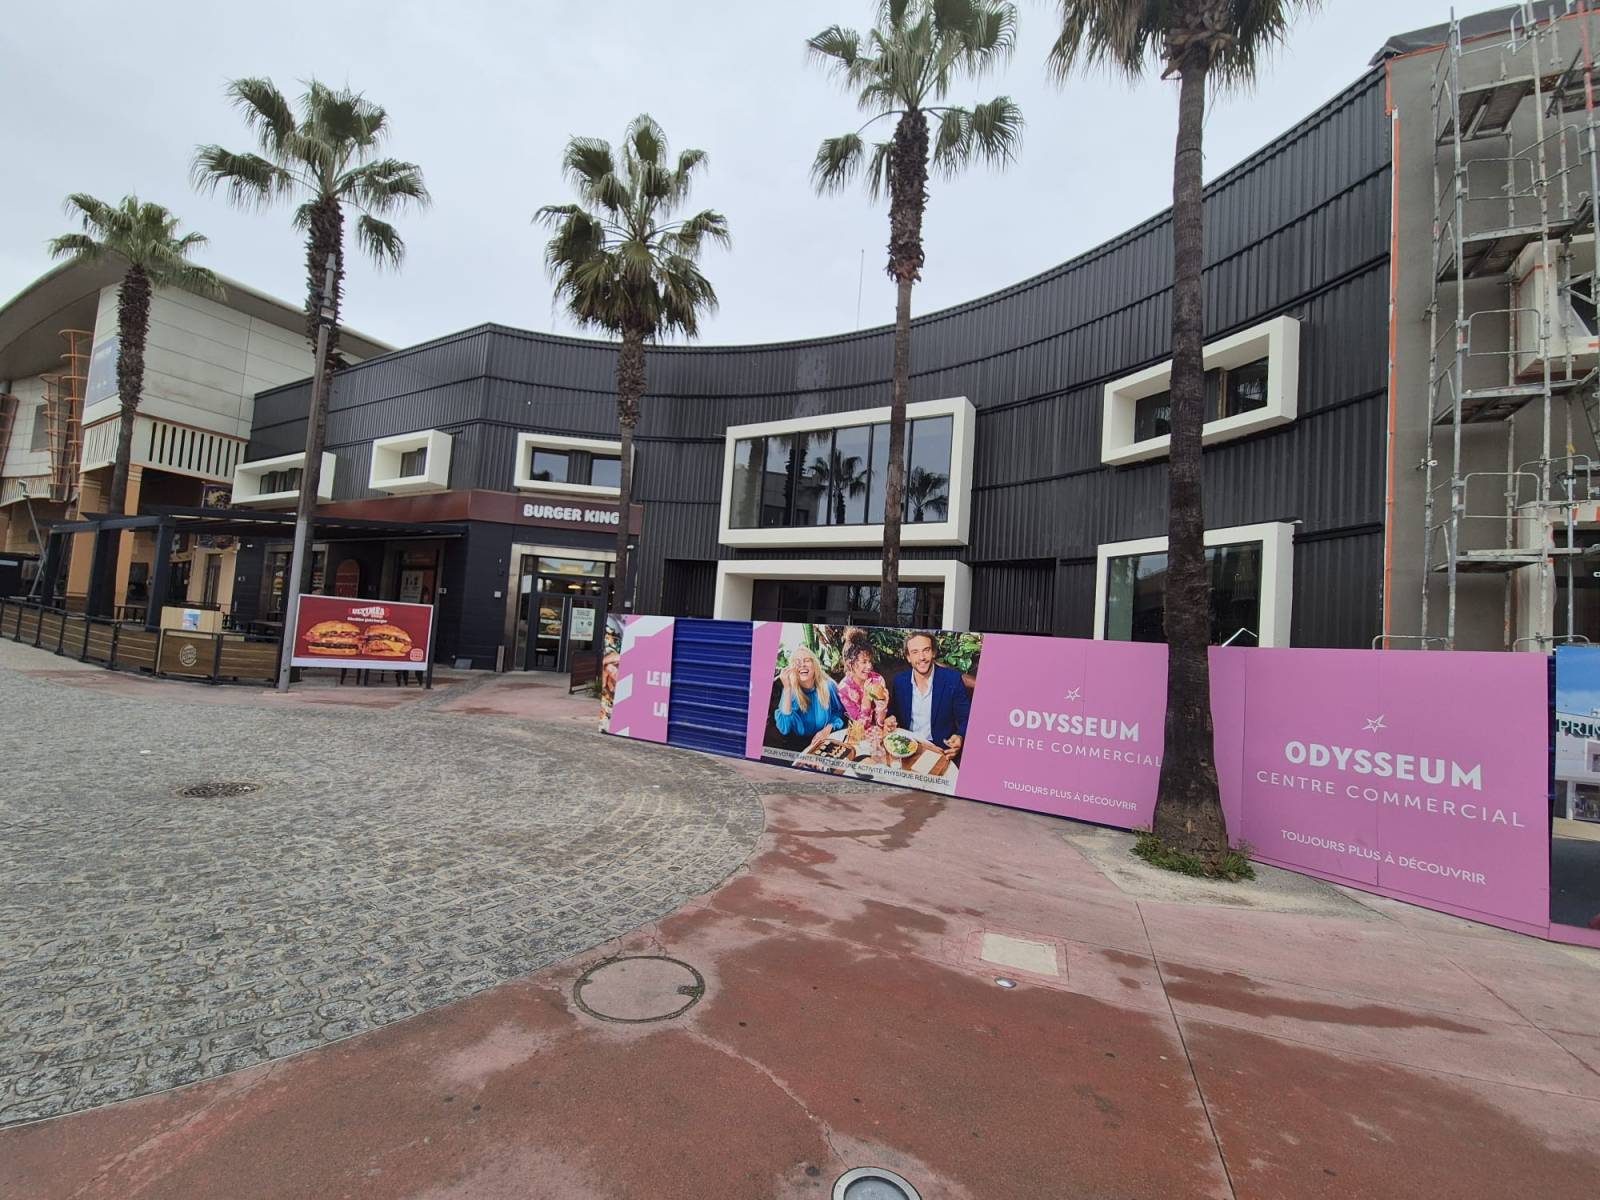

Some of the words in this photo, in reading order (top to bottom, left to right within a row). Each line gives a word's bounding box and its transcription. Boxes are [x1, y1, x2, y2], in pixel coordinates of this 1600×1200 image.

[523, 503, 582, 521] BURGER
[584, 509, 620, 525] KING
[1009, 708, 1140, 742] ODYSSEUM
[987, 733, 1045, 751] CENTRE
[1051, 742, 1163, 768] COMMERCIAL
[1285, 740, 1482, 791] ODYSSEUM
[1003, 780, 1049, 796] TOUJOURS
[1049, 788, 1072, 801] PLUS
[1073, 791, 1082, 802] À
[1082, 794, 1138, 811] DÉCOUVRIR
[1256, 770, 1336, 795] CENTRE
[1346, 785, 1526, 828] COMMERCIAL
[1280, 829, 1345, 853] TOUJOURS
[1348, 844, 1381, 861] PLUS
[1384, 851, 1396, 865] À
[1399, 855, 1487, 885] DÉCOUVRIR
